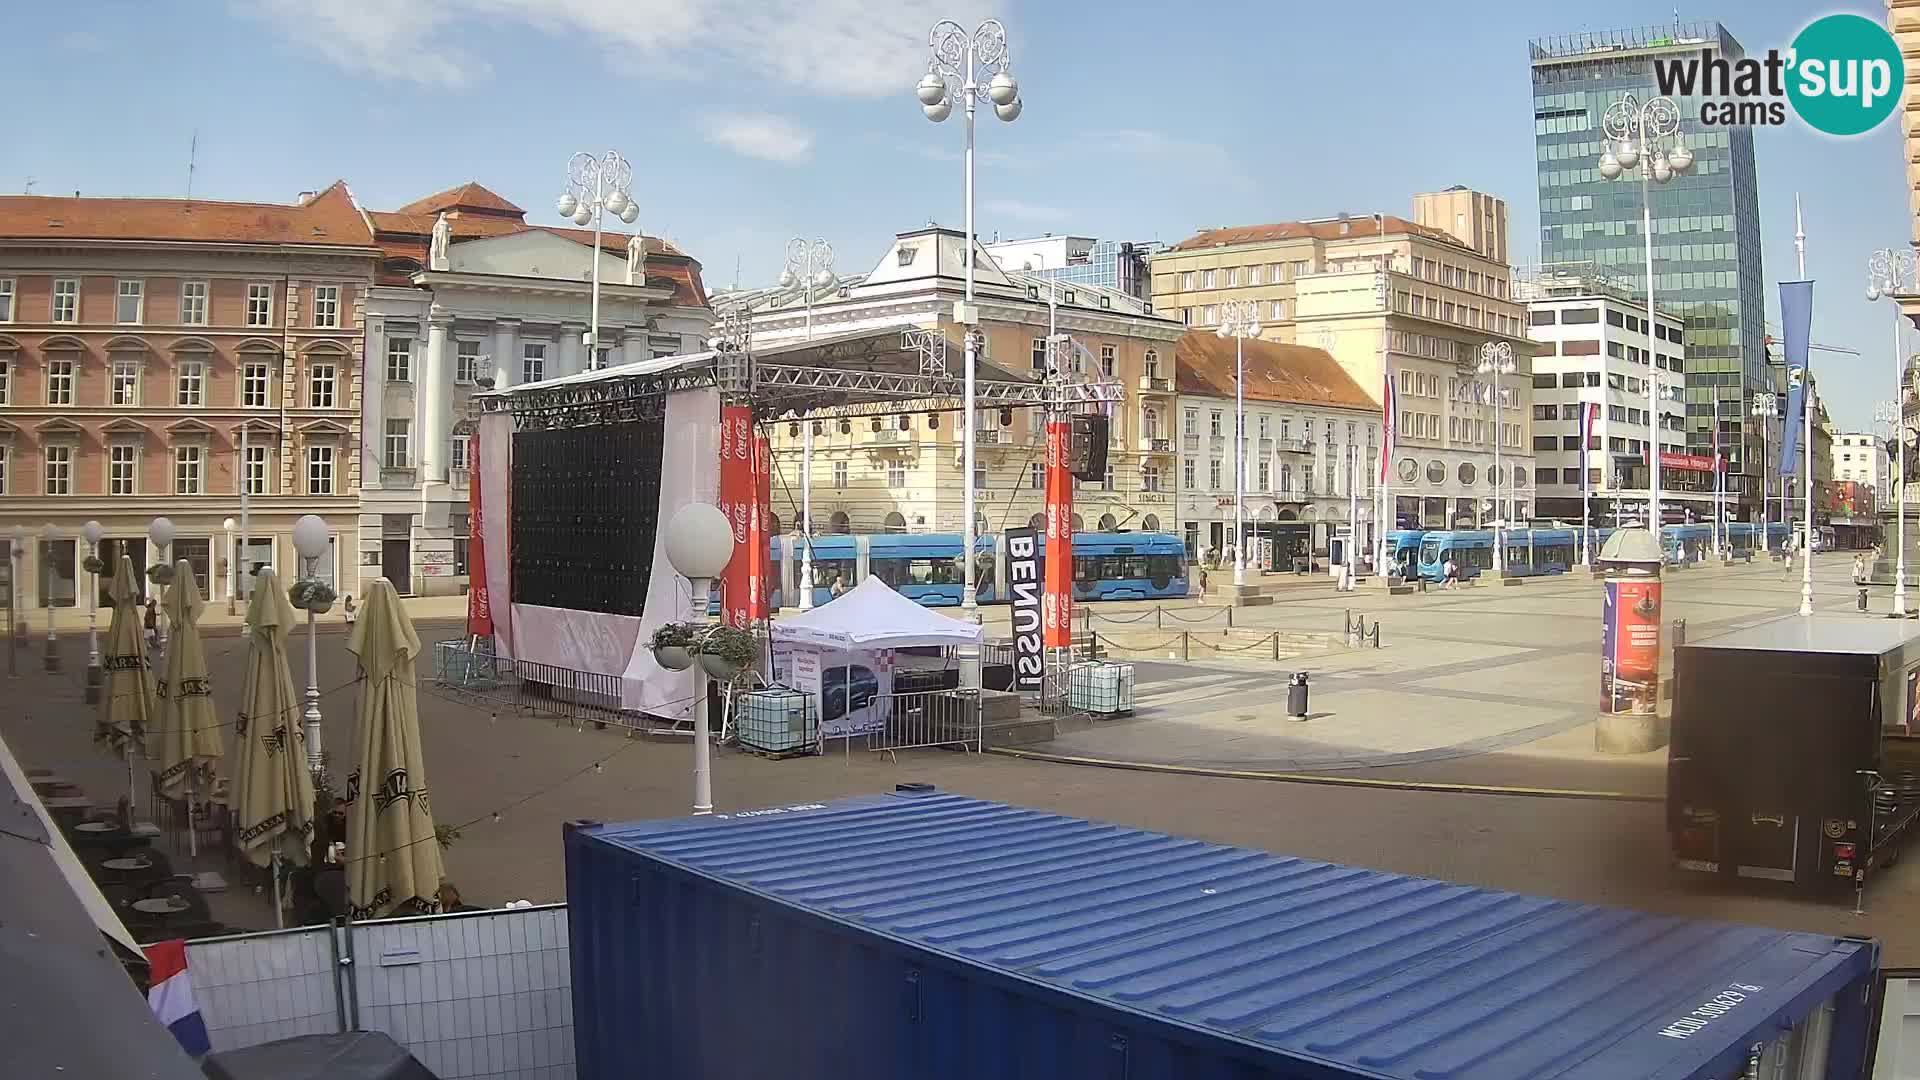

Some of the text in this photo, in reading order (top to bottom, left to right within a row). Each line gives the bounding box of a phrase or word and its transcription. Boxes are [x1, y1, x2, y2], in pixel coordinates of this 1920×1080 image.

[735, 417, 747, 460] Coca-Cola
[1138, 494, 1166, 504] SINGER
[734, 502, 747, 544] Coca-Cola
[1658, 1016, 1708, 1039] MCDU
[1692, 990, 1746, 1019] 300629
